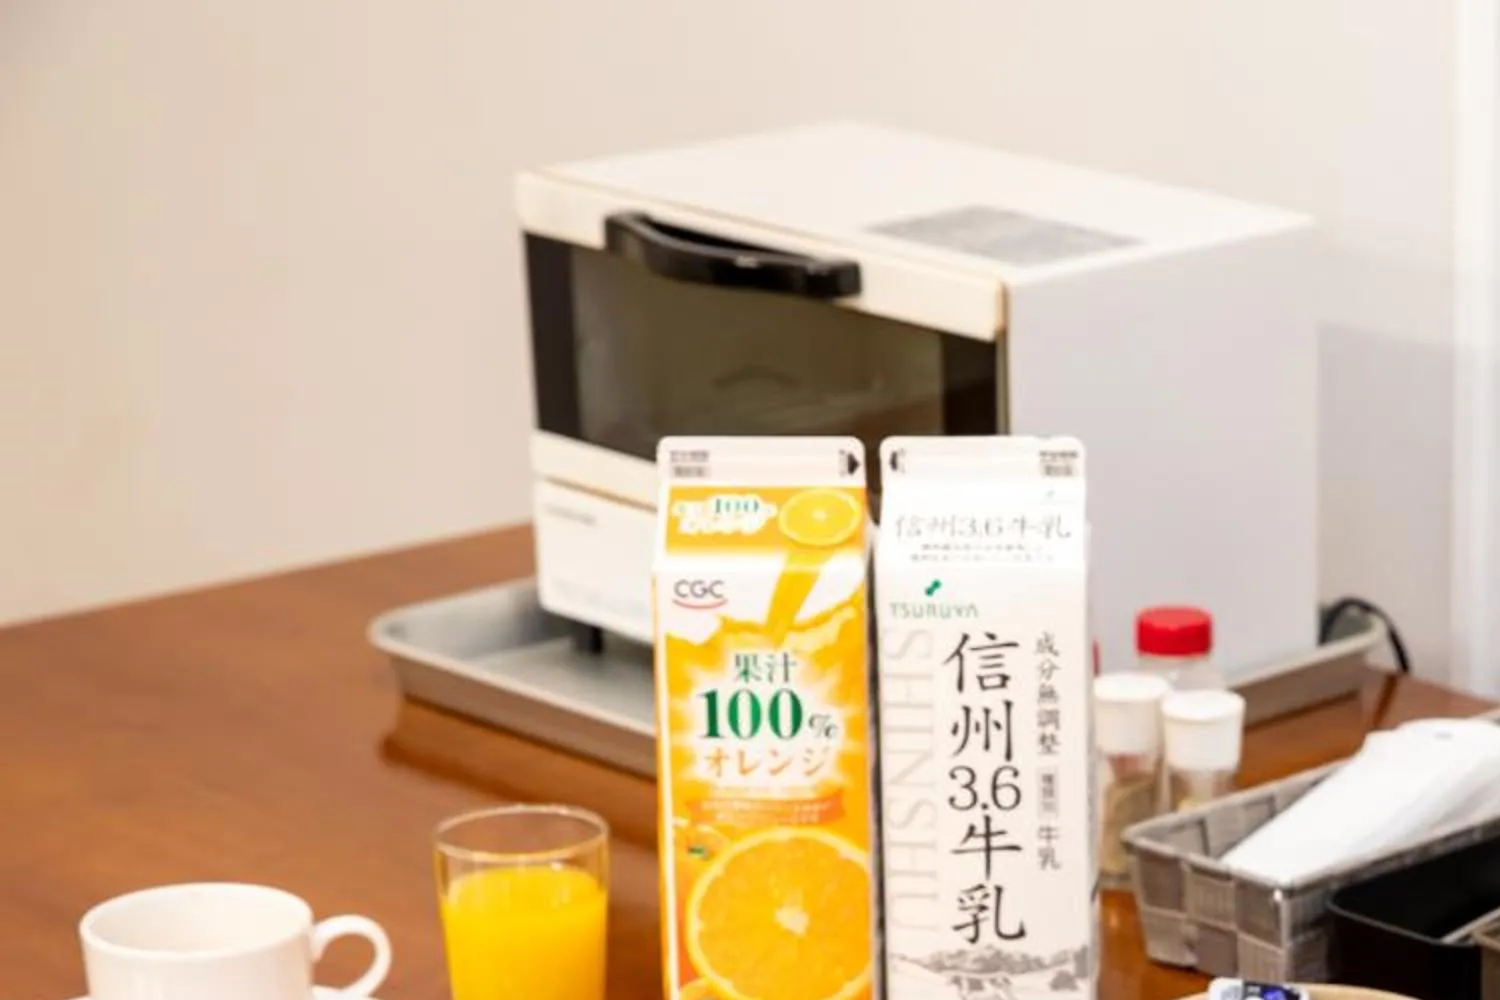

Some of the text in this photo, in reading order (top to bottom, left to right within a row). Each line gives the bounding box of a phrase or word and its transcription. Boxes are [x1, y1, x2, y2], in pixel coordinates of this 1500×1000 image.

[673, 578, 725, 600] CGC
[889, 602, 979, 619] TSURUYA
[734, 652, 797, 684] 果汁
[699, 688, 838, 740] 100%
[704, 746, 830, 777] オレンジ
